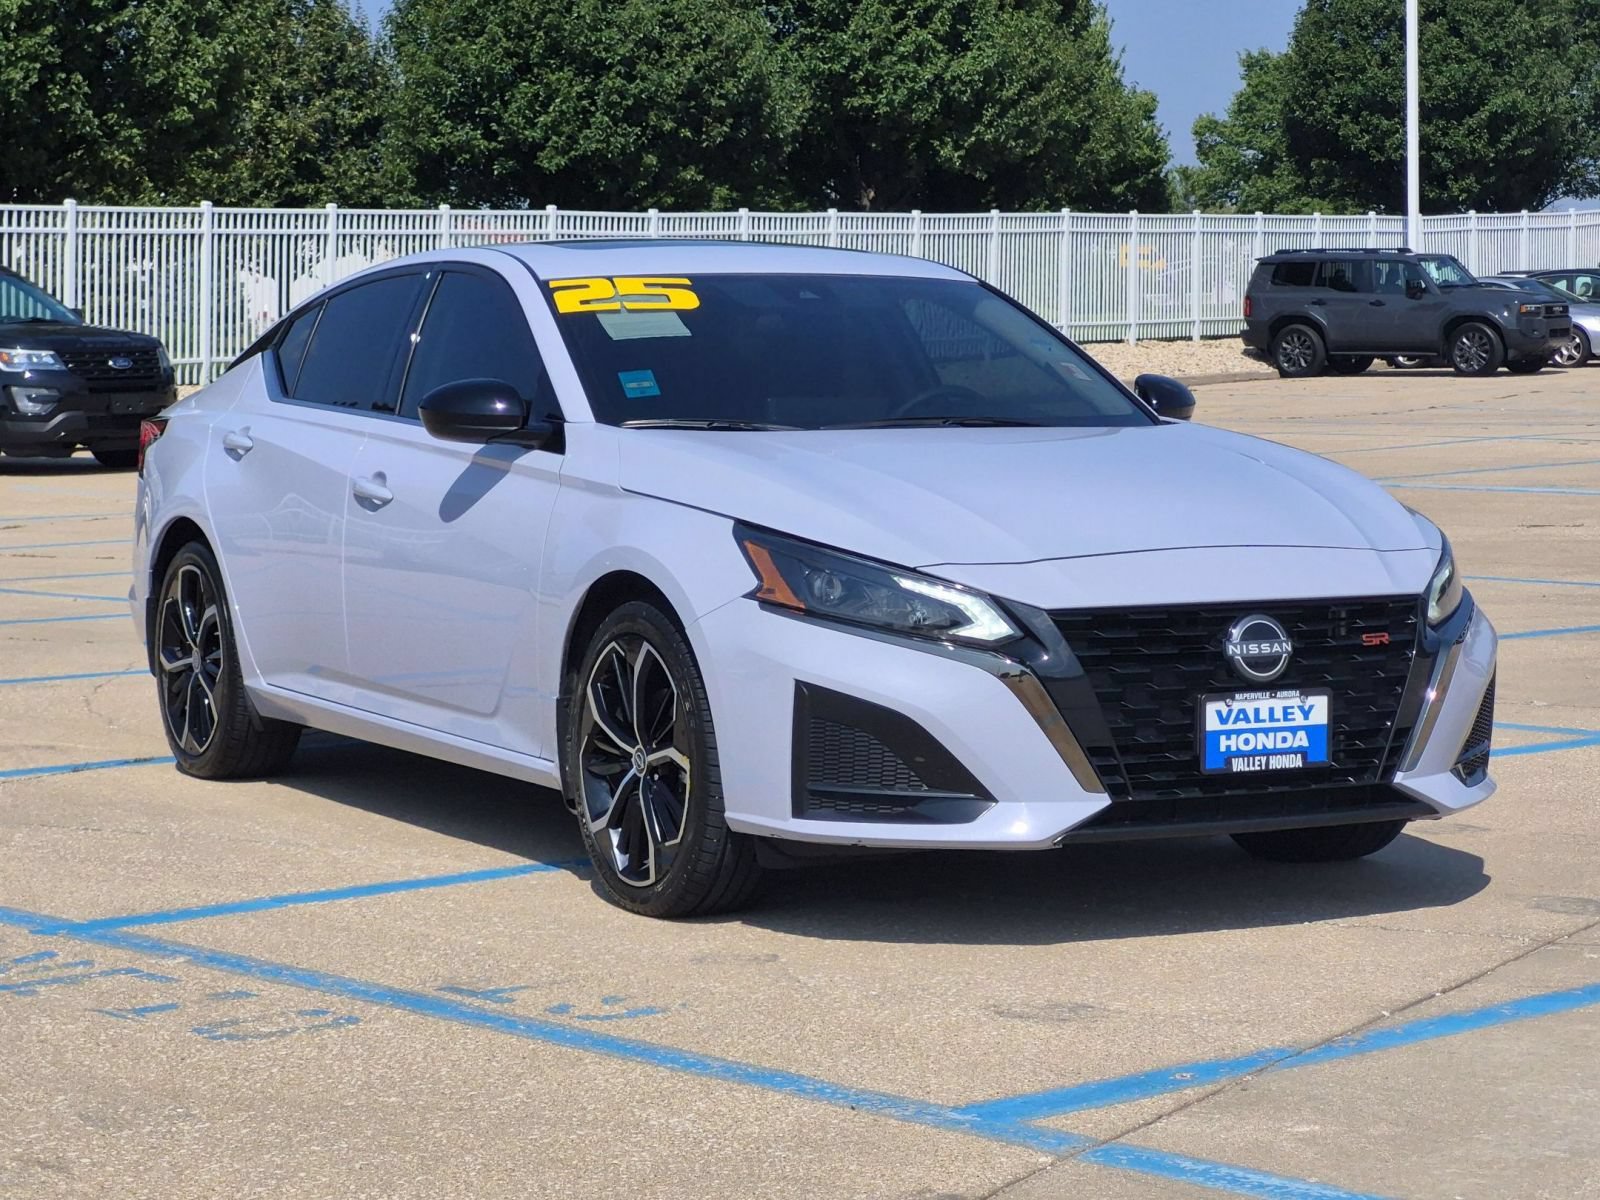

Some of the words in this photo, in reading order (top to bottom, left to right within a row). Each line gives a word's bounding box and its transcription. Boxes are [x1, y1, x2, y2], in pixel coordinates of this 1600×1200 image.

[549, 277, 700, 313] 25
[1362, 632, 1389, 645] SR
[1229, 642, 1292, 655] NISSAN
[1235, 692, 1270, 701] NAPERVILLE
[1276, 690, 1300, 698] AURORA
[1215, 704, 1315, 725] VALLEY
[1220, 730, 1309, 752] HONDA
[1232, 756, 1267, 772] VALLEY
[1269, 753, 1302, 770] HONDA
